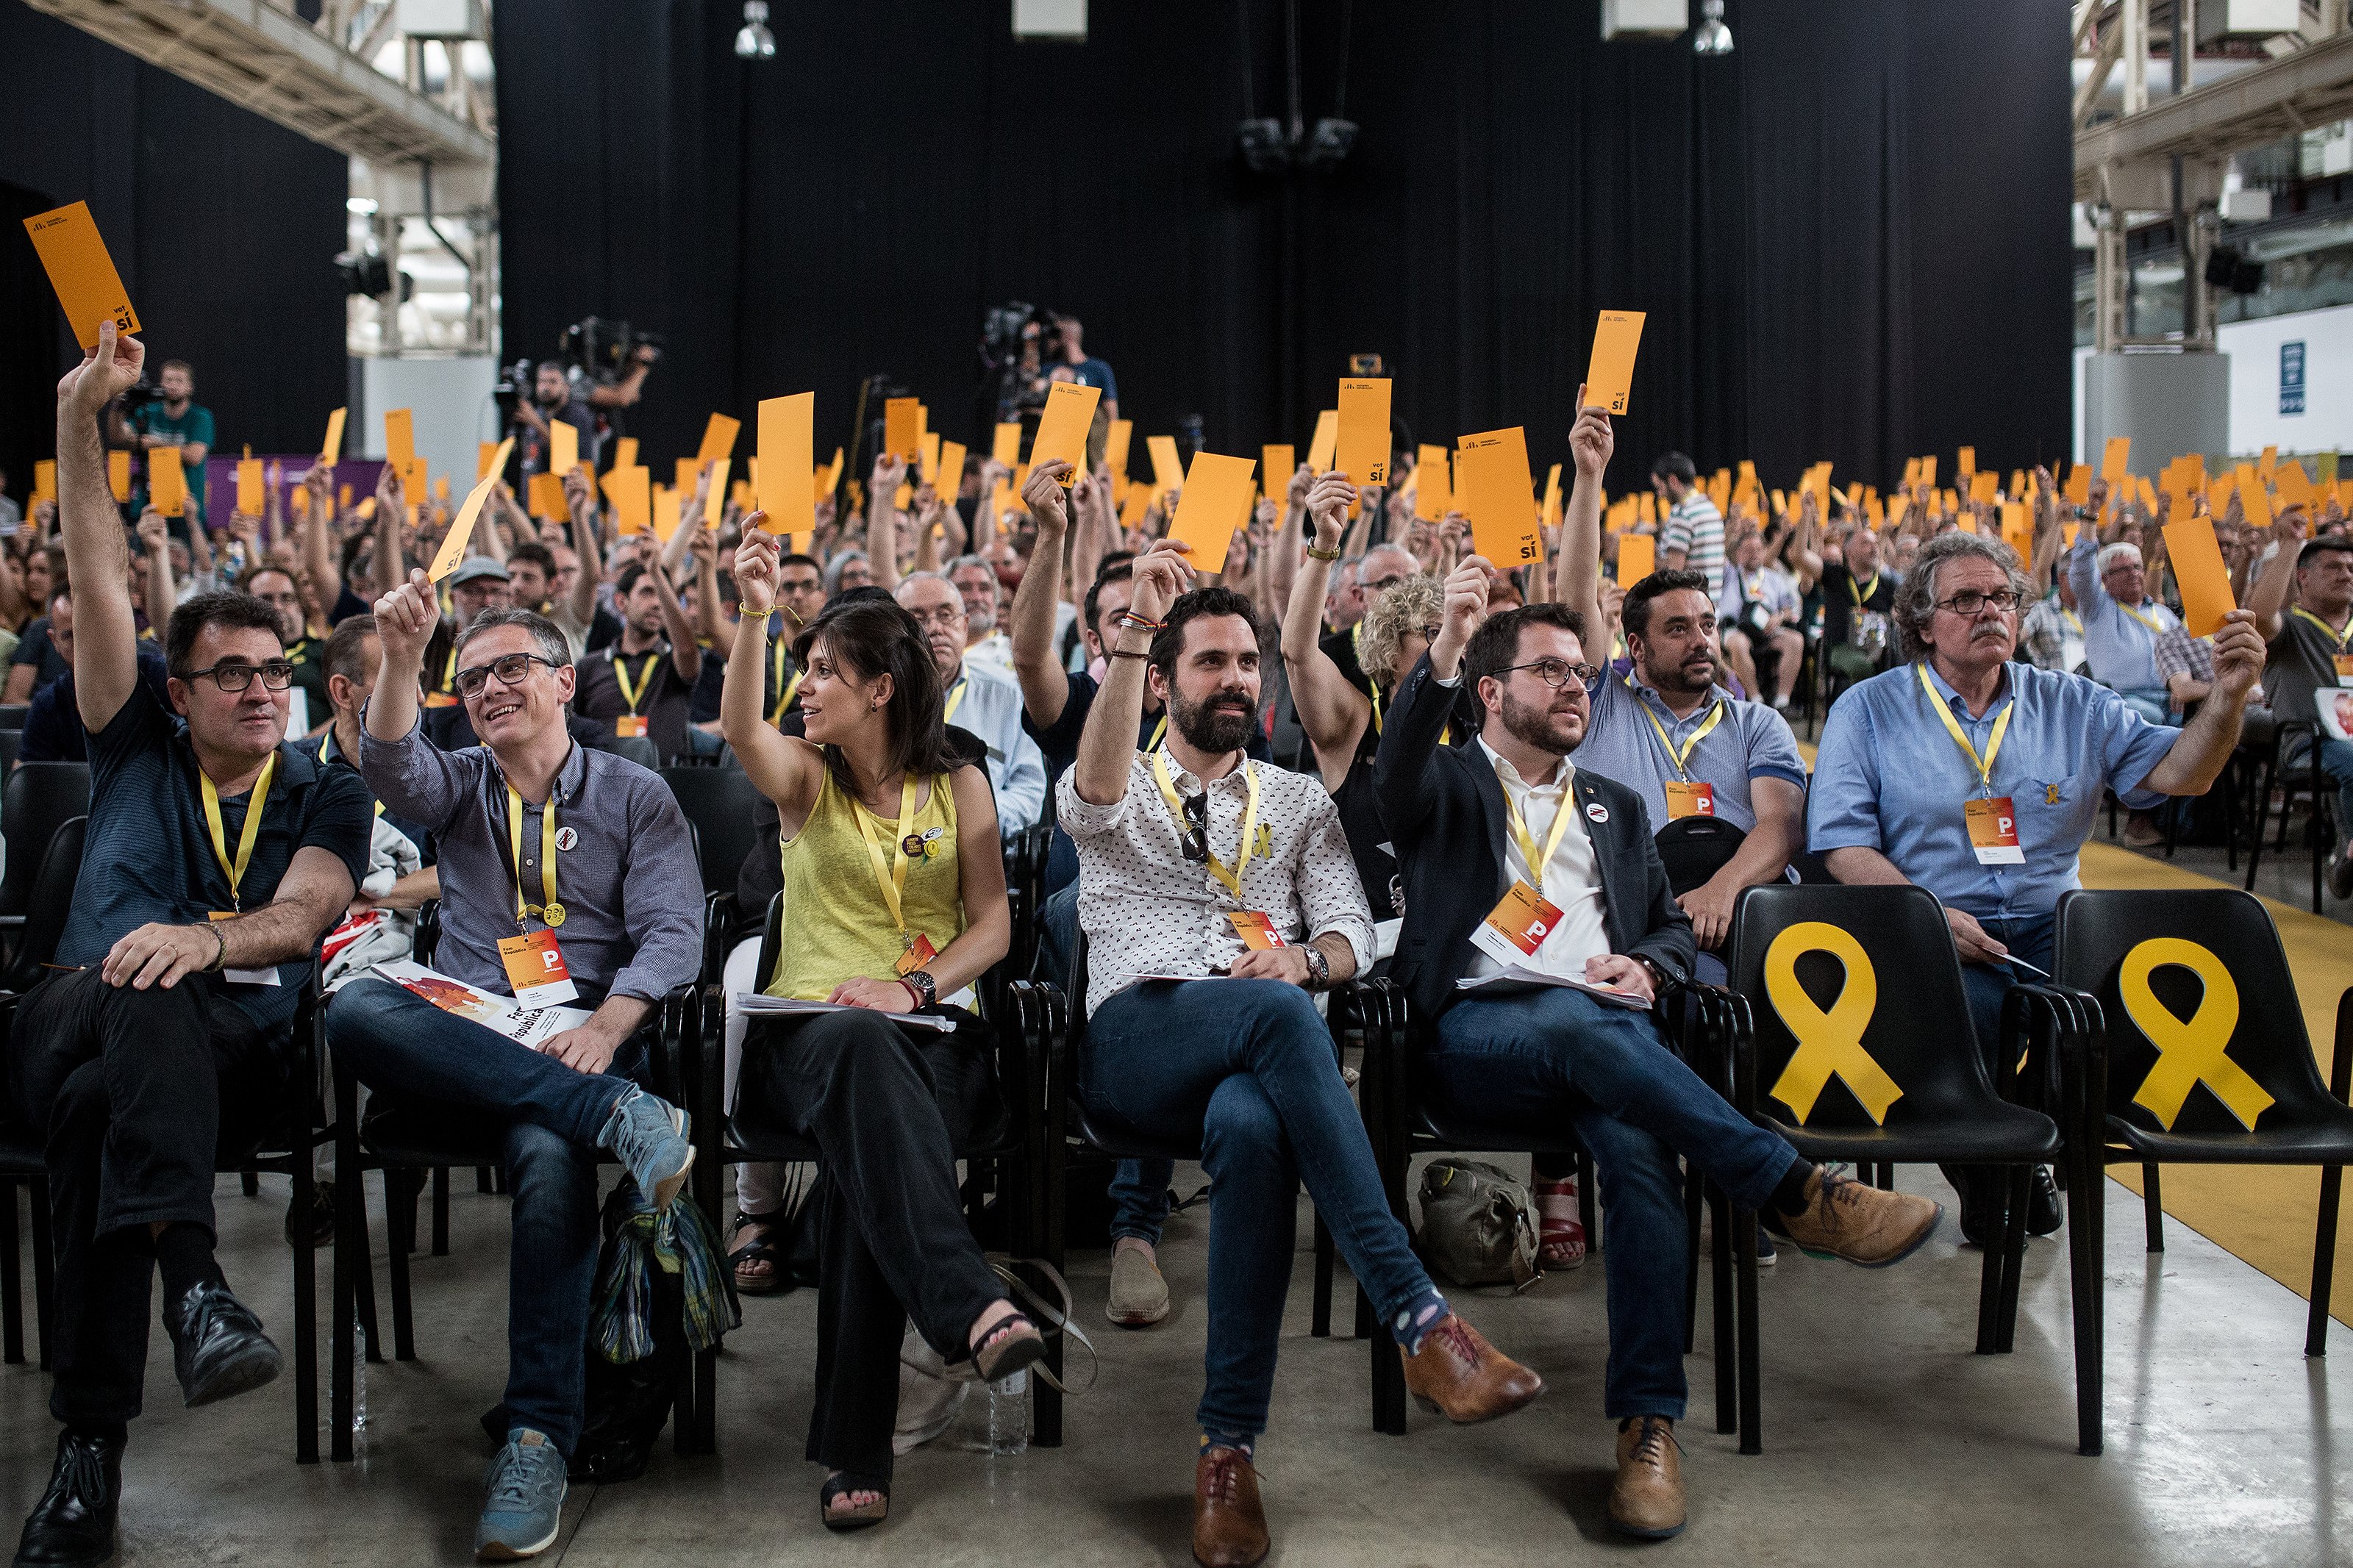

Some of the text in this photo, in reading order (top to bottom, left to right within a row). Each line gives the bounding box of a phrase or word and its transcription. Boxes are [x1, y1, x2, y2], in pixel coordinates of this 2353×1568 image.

[113, 305, 126, 313] vot
[117, 311, 133, 331] sí
[1612, 398, 1624, 410] sí
[1057, 471, 1073, 483] sí
[1370, 468, 1384, 482] sí
[1521, 540, 1537, 559] sí
[446, 552, 461, 570] sí
[1697, 797, 1710, 811] P
[1999, 817, 2013, 834] P
[1526, 919, 1547, 937] P
[1264, 931, 1279, 946] P
[541, 950, 559, 968] P
[508, 1008, 544, 1040] República
